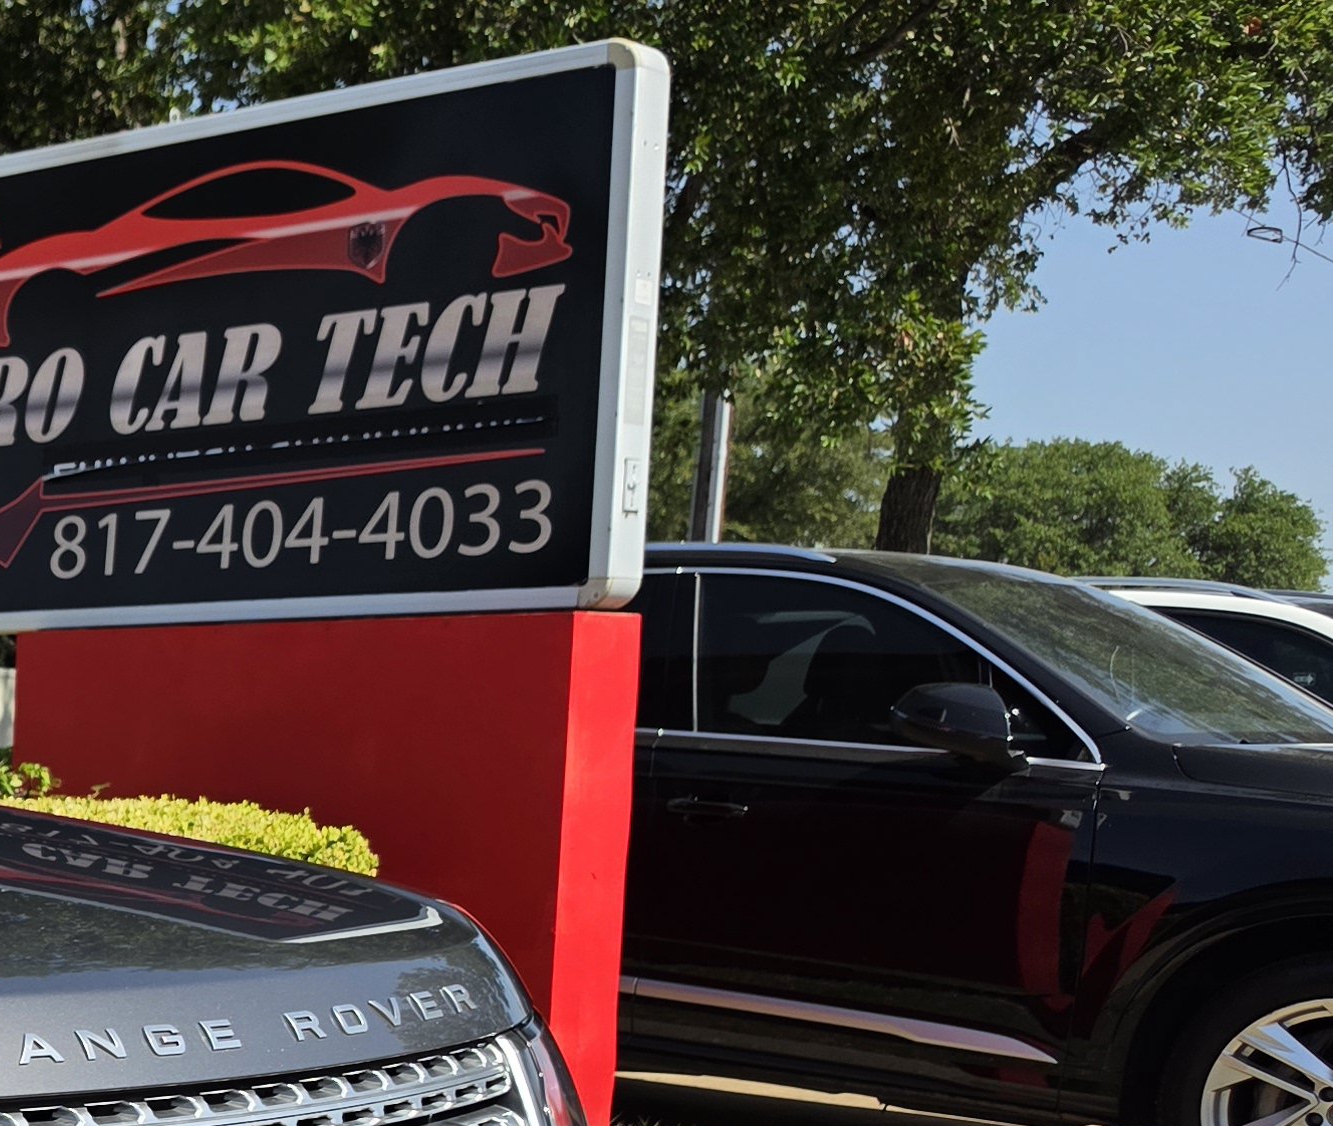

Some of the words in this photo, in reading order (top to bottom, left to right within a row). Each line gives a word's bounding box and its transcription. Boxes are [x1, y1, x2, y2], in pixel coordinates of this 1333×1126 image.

[109, 323, 283, 436] CAR
[307, 283, 566, 415] TECH
[49, 479, 554, 580] 817-404-4033
[281, 983, 479, 1042] ROVER
